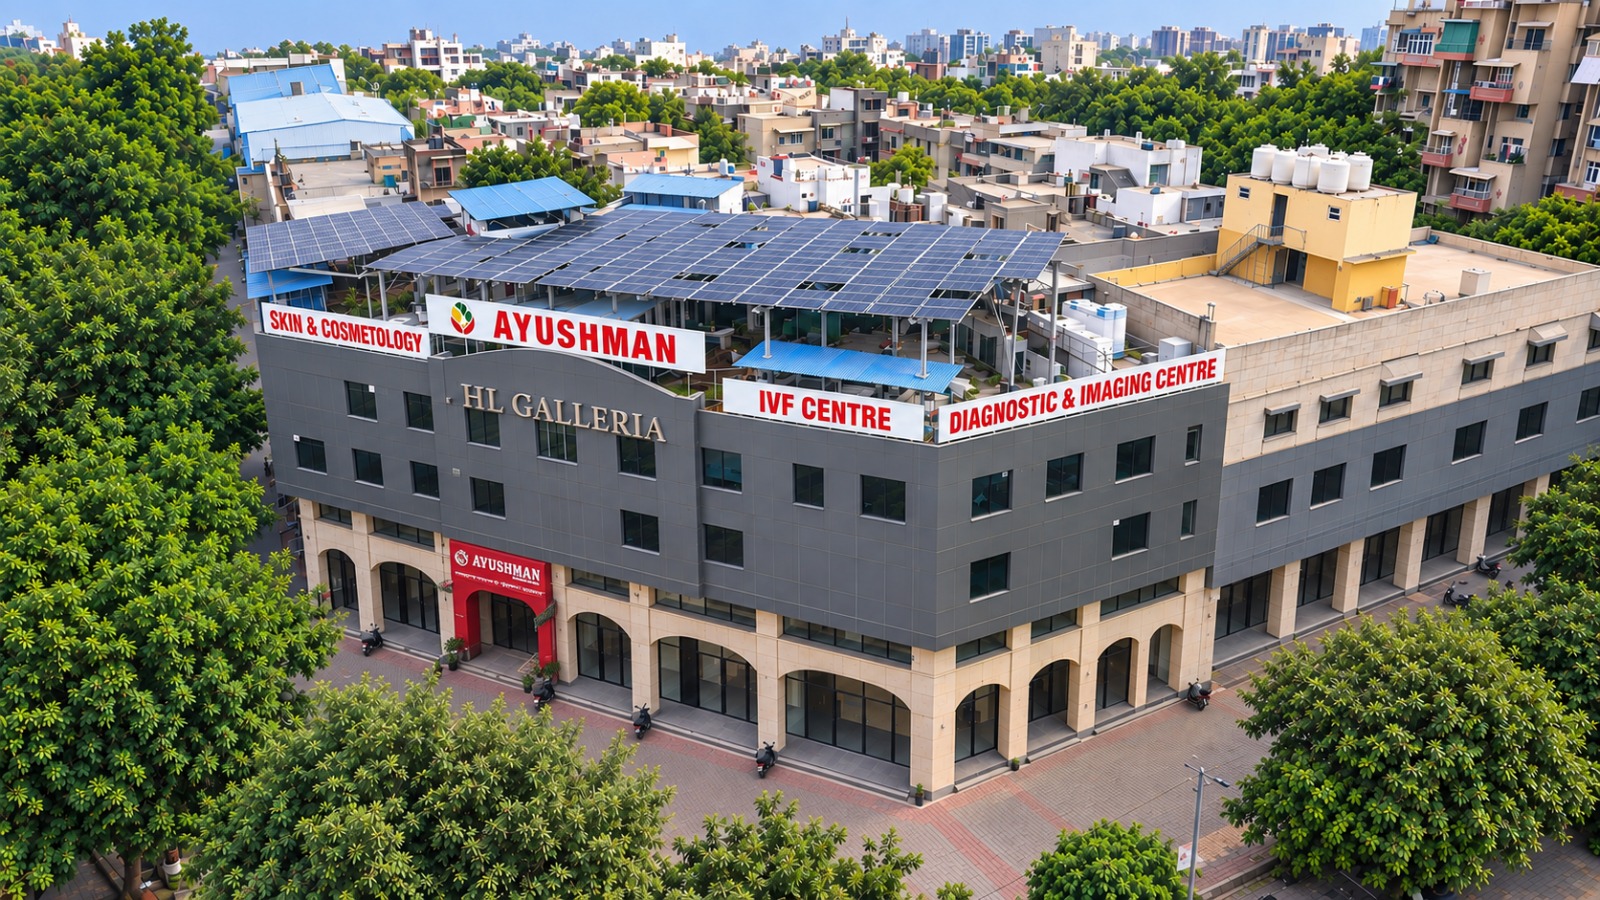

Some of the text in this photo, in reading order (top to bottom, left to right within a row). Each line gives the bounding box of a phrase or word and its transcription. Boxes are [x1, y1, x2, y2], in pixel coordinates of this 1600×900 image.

[269, 309, 423, 353] SKIN & COSMETOLOGY
[493, 309, 677, 365] AYUSHMAN
[461, 383, 666, 442] HL GALLERIA
[759, 389, 892, 437] IVF CENTRE
[949, 357, 1217, 435] DIAGNOSTIC & IMAGING CENTRE
[472, 554, 540, 582] AYUSHMAN
